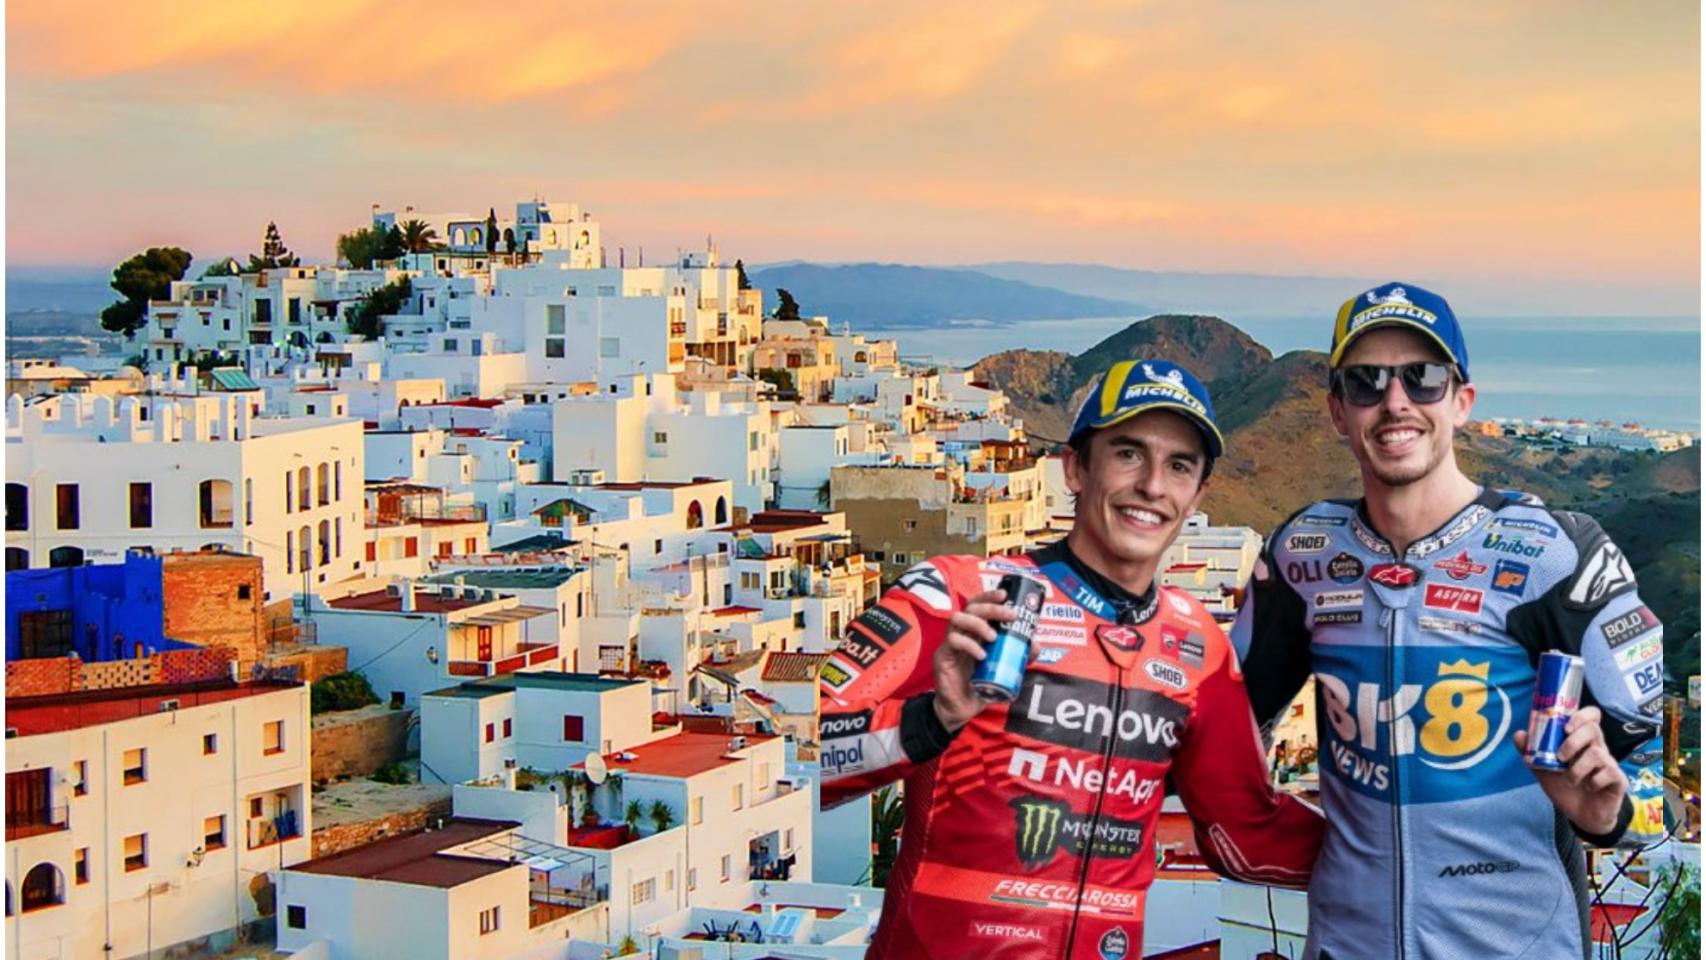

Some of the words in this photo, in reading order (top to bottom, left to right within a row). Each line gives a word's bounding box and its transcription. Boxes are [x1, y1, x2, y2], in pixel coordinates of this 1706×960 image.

[1351, 306, 1438, 329] MICHELIN
[1125, 387, 1207, 415] MICHELIN
[1289, 535, 1326, 550] SHOEI
[1482, 532, 1545, 558] Unibat
[1046, 606, 1082, 619] riello
[1075, 587, 1104, 613] TIM
[1605, 611, 1642, 638] BOLD
[1151, 664, 1183, 686] SHOEI
[1027, 684, 1179, 747] Lenovo
[1316, 673, 1489, 757] BK8
[1330, 740, 1390, 791] NEWS
[1062, 819, 1141, 844] MONSTER
[975, 924, 1043, 939] VERTICAL
